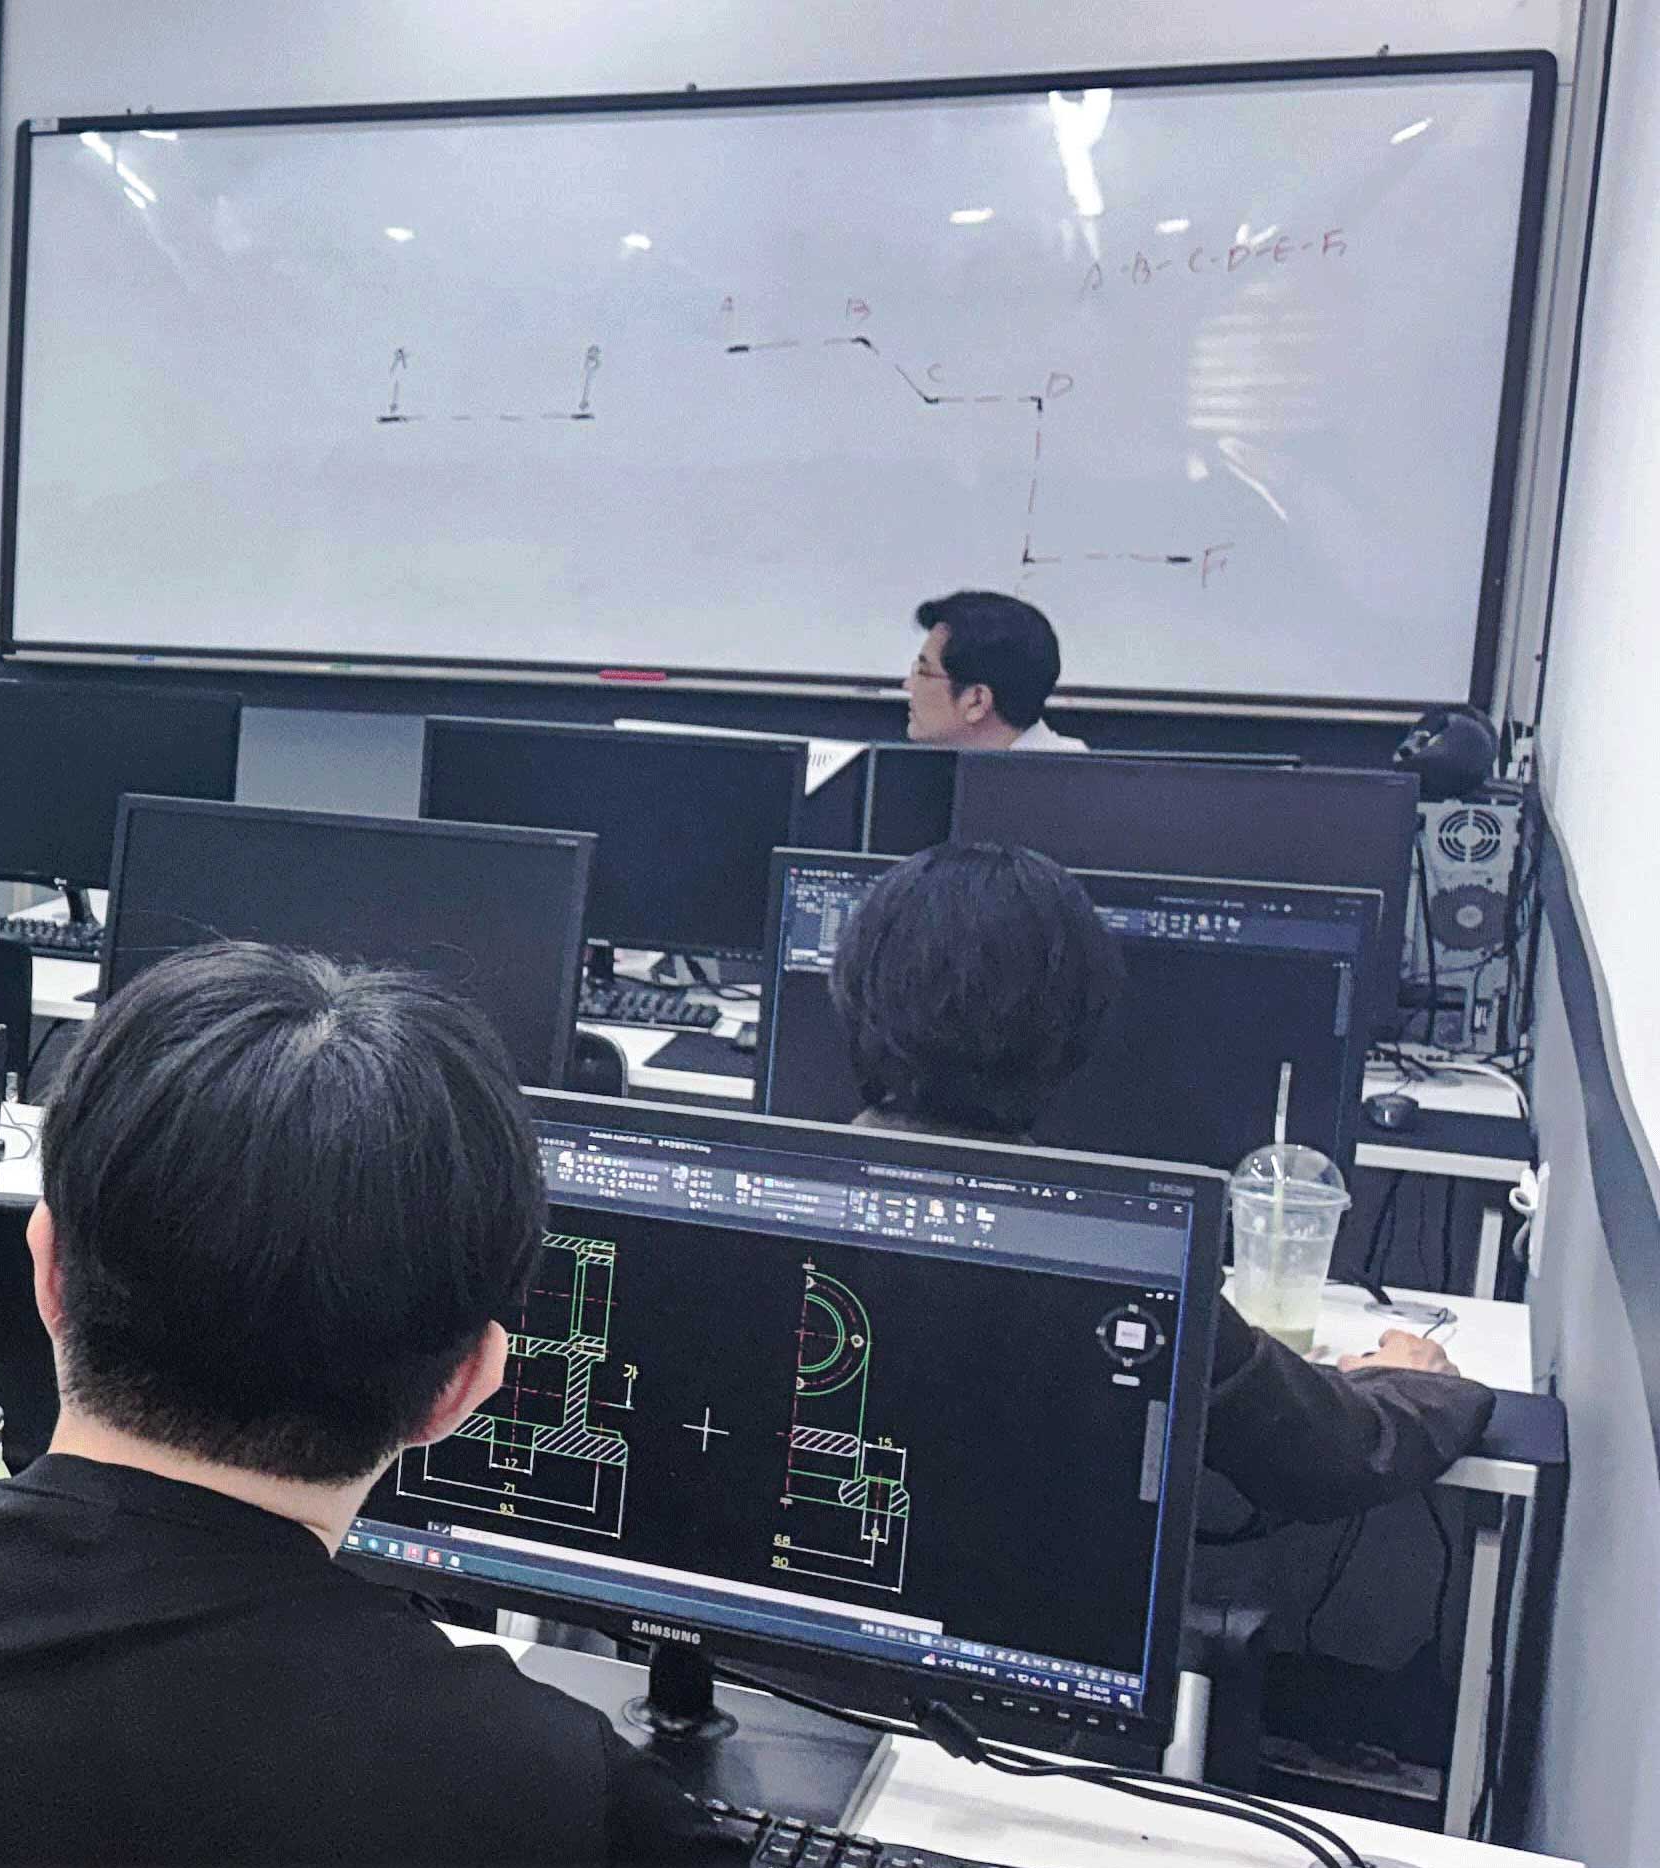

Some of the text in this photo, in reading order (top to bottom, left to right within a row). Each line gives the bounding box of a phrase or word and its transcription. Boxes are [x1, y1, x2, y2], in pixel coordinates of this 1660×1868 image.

[1046, 371, 1073, 397] D
[622, 1363, 639, 1380] 가
[877, 1436, 893, 1448] 15
[504, 1457, 518, 1468] 17
[503, 1482, 516, 1494] 71
[499, 1502, 515, 1515] 93
[773, 1533, 791, 1546] 68
[772, 1555, 789, 1568] 90
[631, 1619, 701, 1645] SAMSUNG
